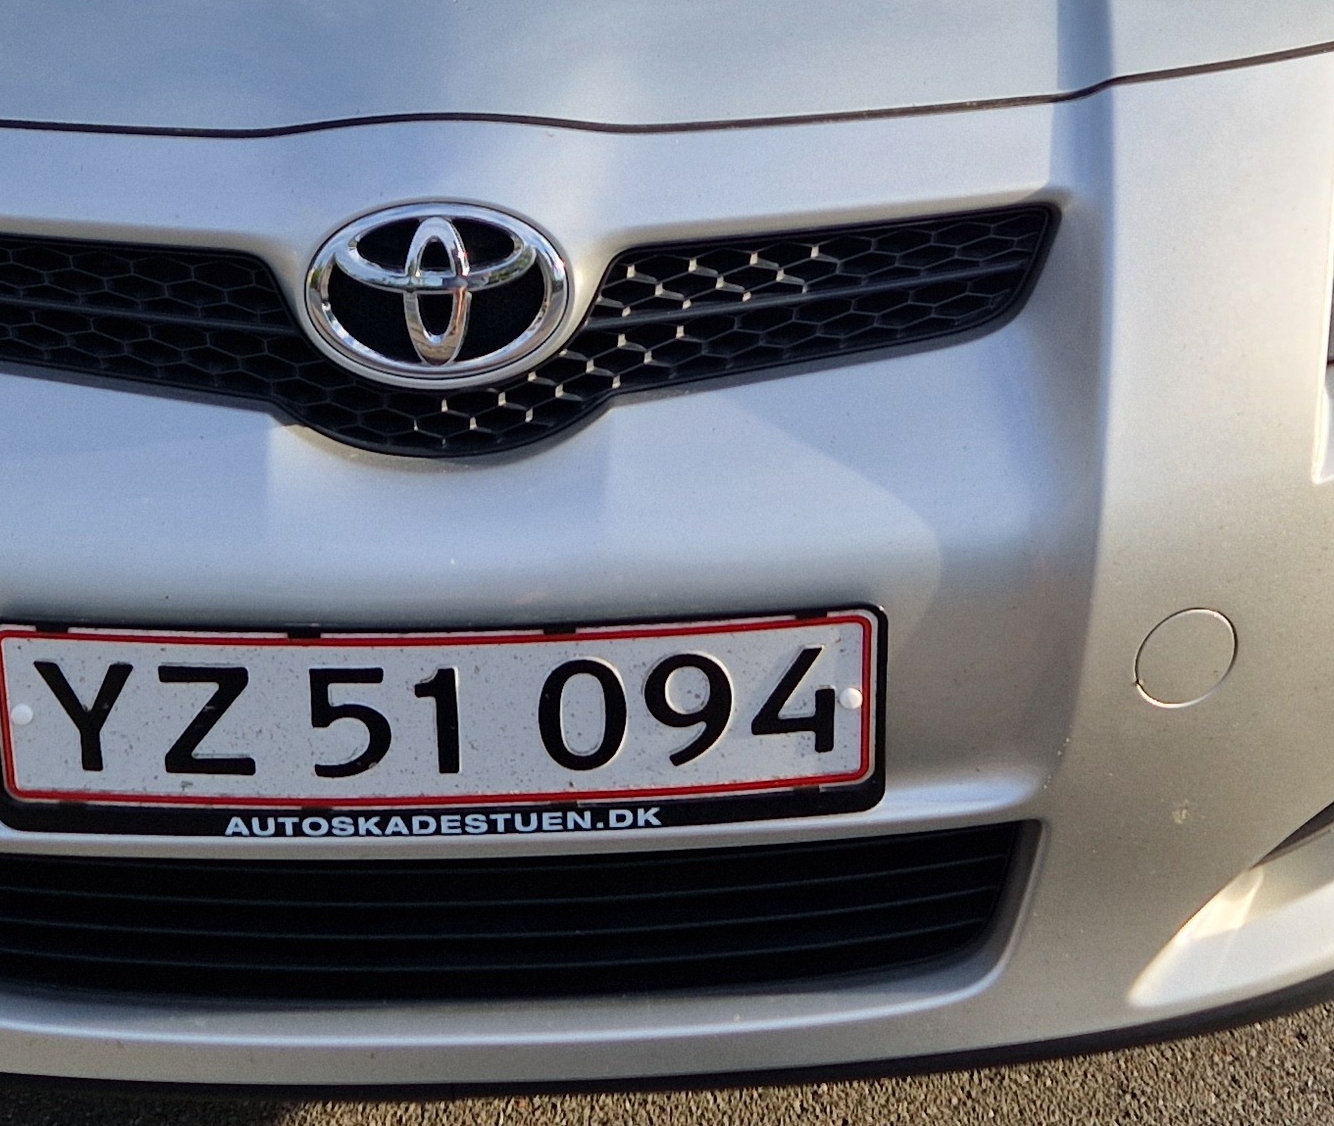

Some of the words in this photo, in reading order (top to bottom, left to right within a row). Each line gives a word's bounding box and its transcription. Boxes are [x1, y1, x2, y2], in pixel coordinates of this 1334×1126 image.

[33, 660, 257, 777] YZ
[308, 665, 462, 779] 51
[537, 646, 836, 772] 094
[224, 806, 663, 838] AUTOSKADESTUEN.DK
